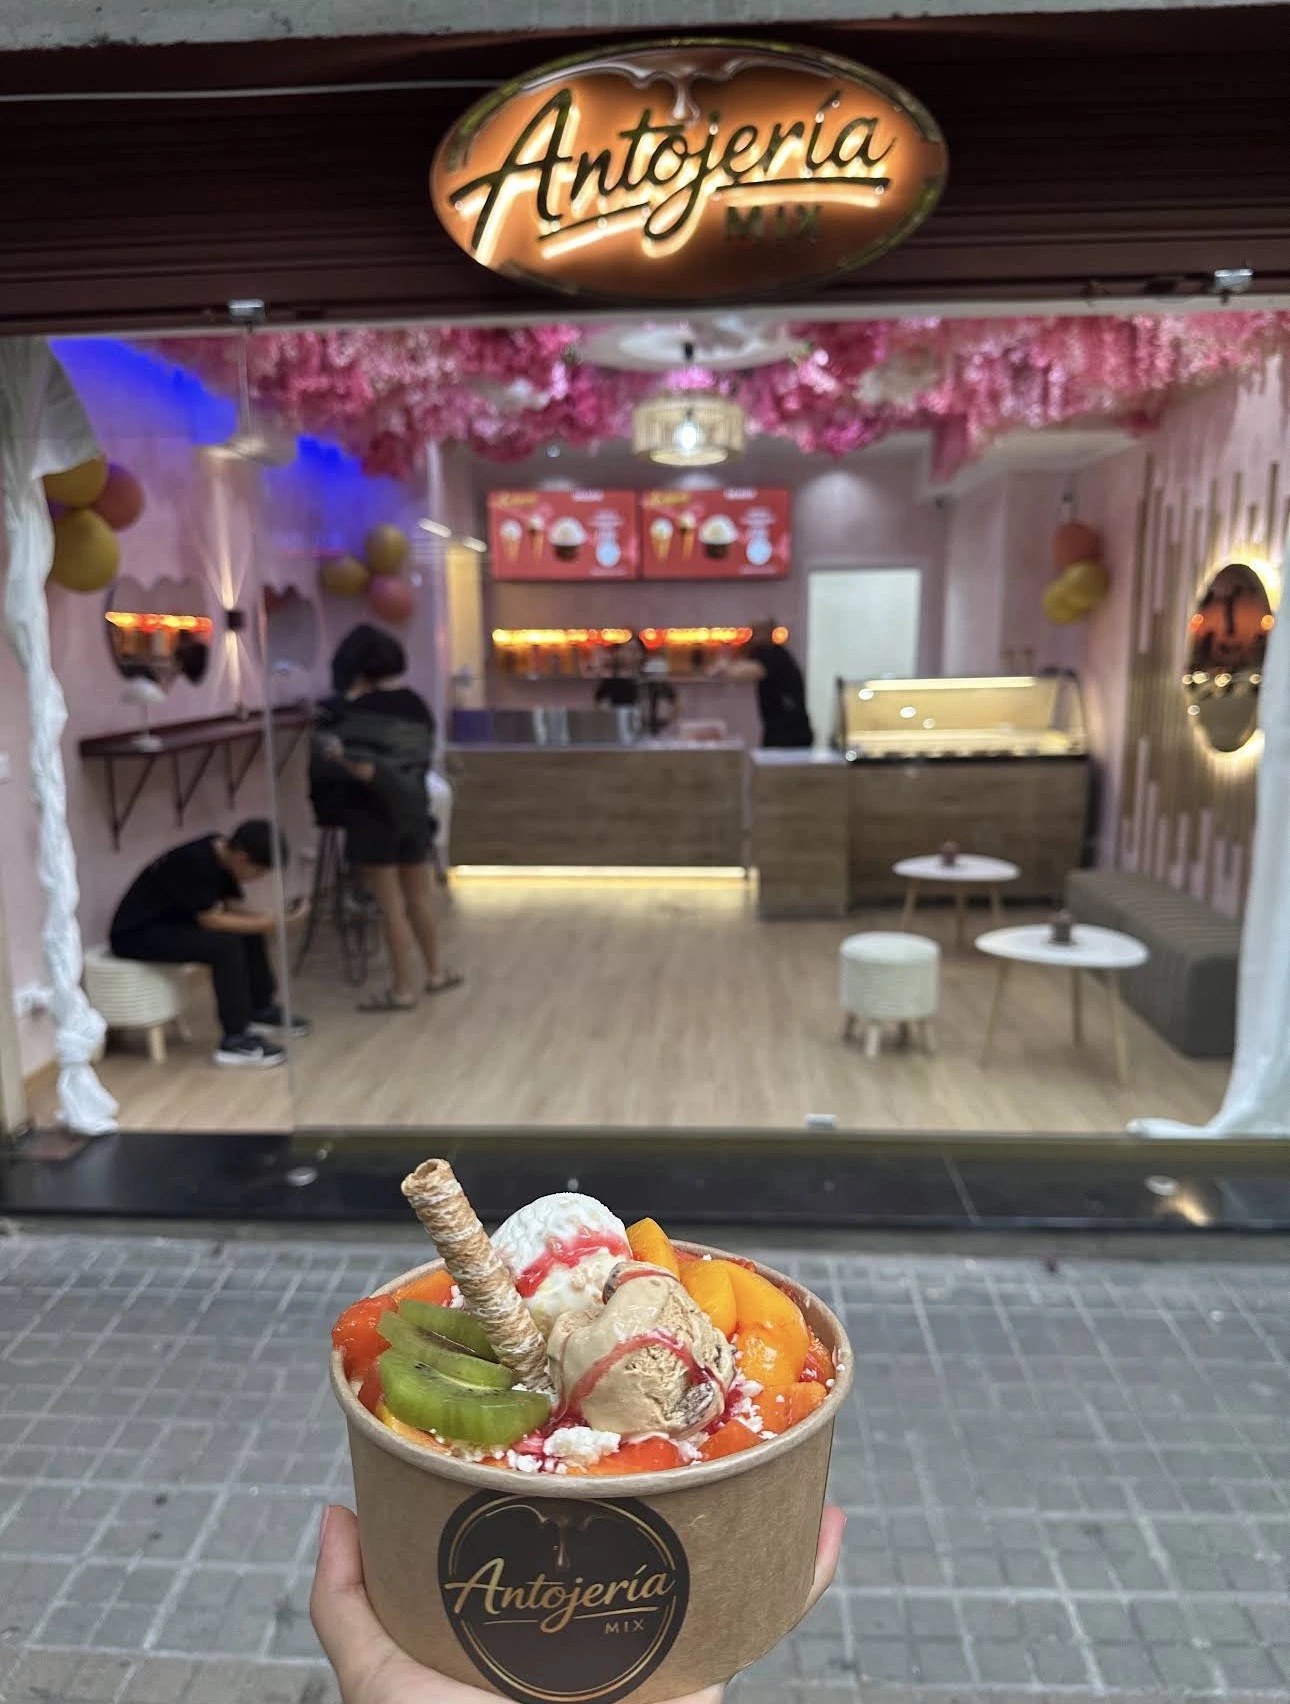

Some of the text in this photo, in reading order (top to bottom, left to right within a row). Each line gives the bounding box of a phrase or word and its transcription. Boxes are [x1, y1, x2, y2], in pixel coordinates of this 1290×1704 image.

[450, 88, 896, 250] Antojería
[724, 206, 822, 239] MIX
[444, 1557, 676, 1633] Antojería
[605, 1619, 645, 1634] MIX
